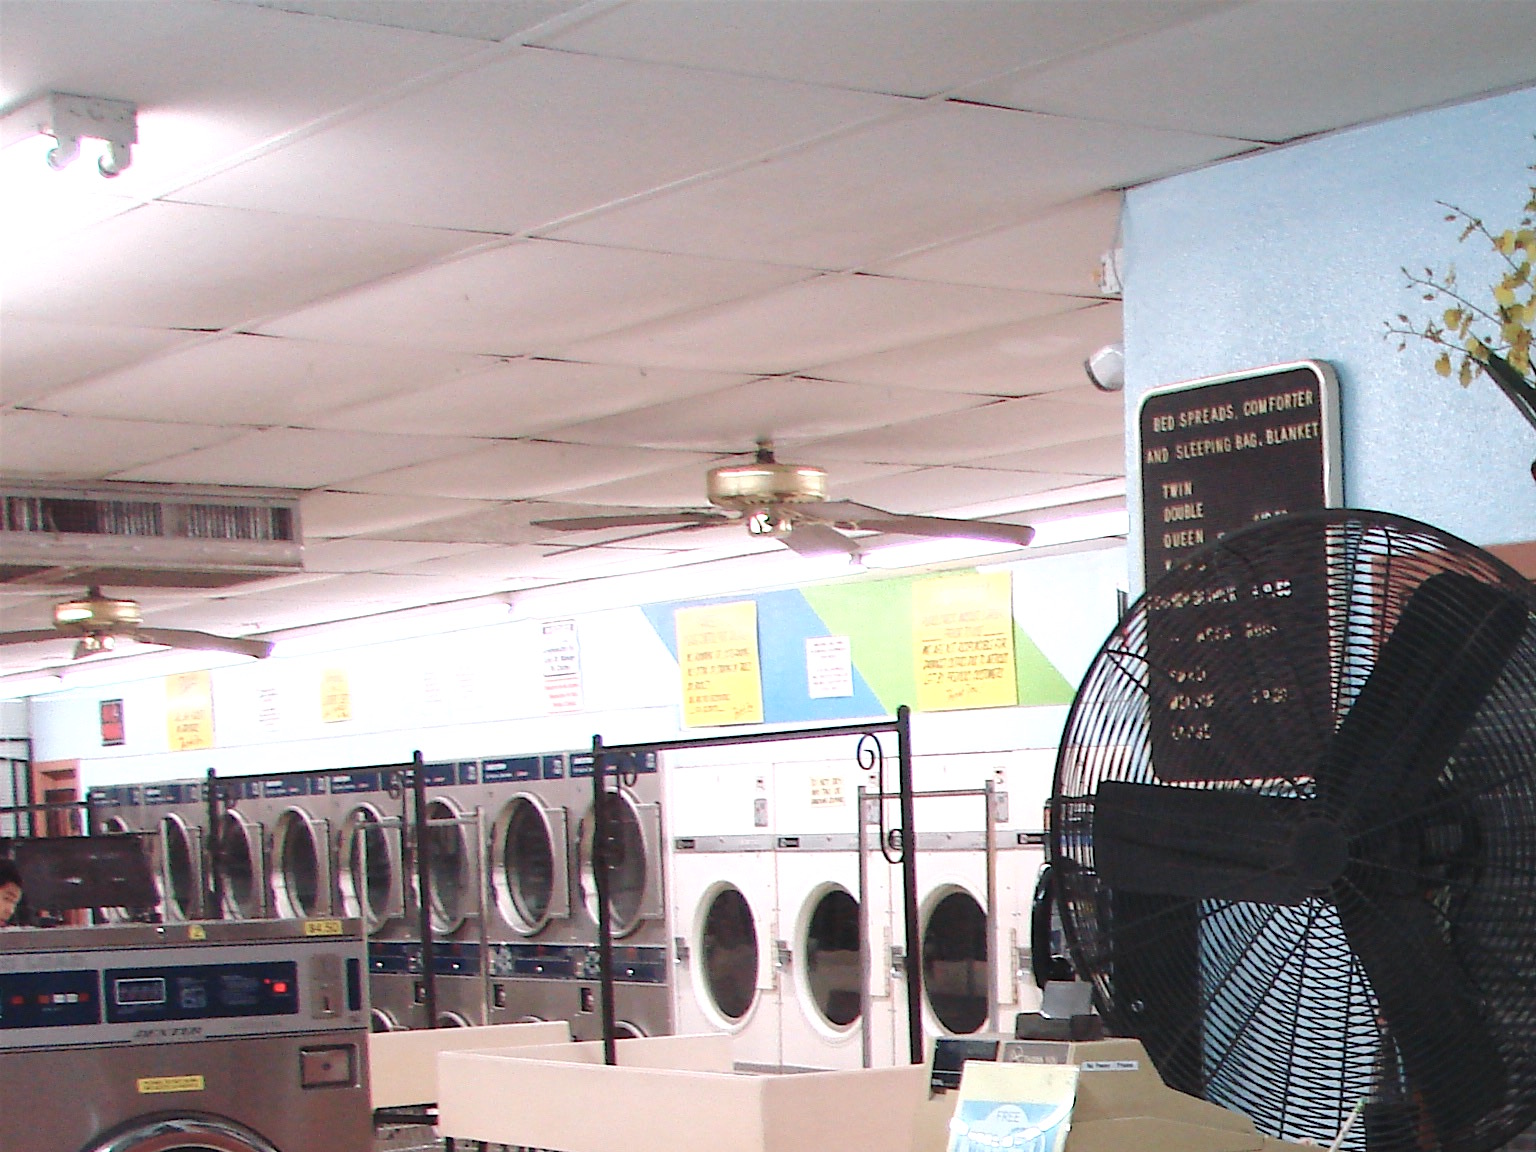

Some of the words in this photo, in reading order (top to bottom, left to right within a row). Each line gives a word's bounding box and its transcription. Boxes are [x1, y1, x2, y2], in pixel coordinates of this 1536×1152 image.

[1153, 416, 1175, 433] BED
[1243, 390, 1313, 417] COMFORTER
[1147, 449, 1169, 464] AND
[1176, 437, 1232, 460] SLEEPING
[1265, 422, 1319, 445] BLANKET
[1162, 481, 1193, 500] TWIN
[1164, 502, 1204, 523] DOUBLE
[1163, 529, 1204, 549] QUEEN
